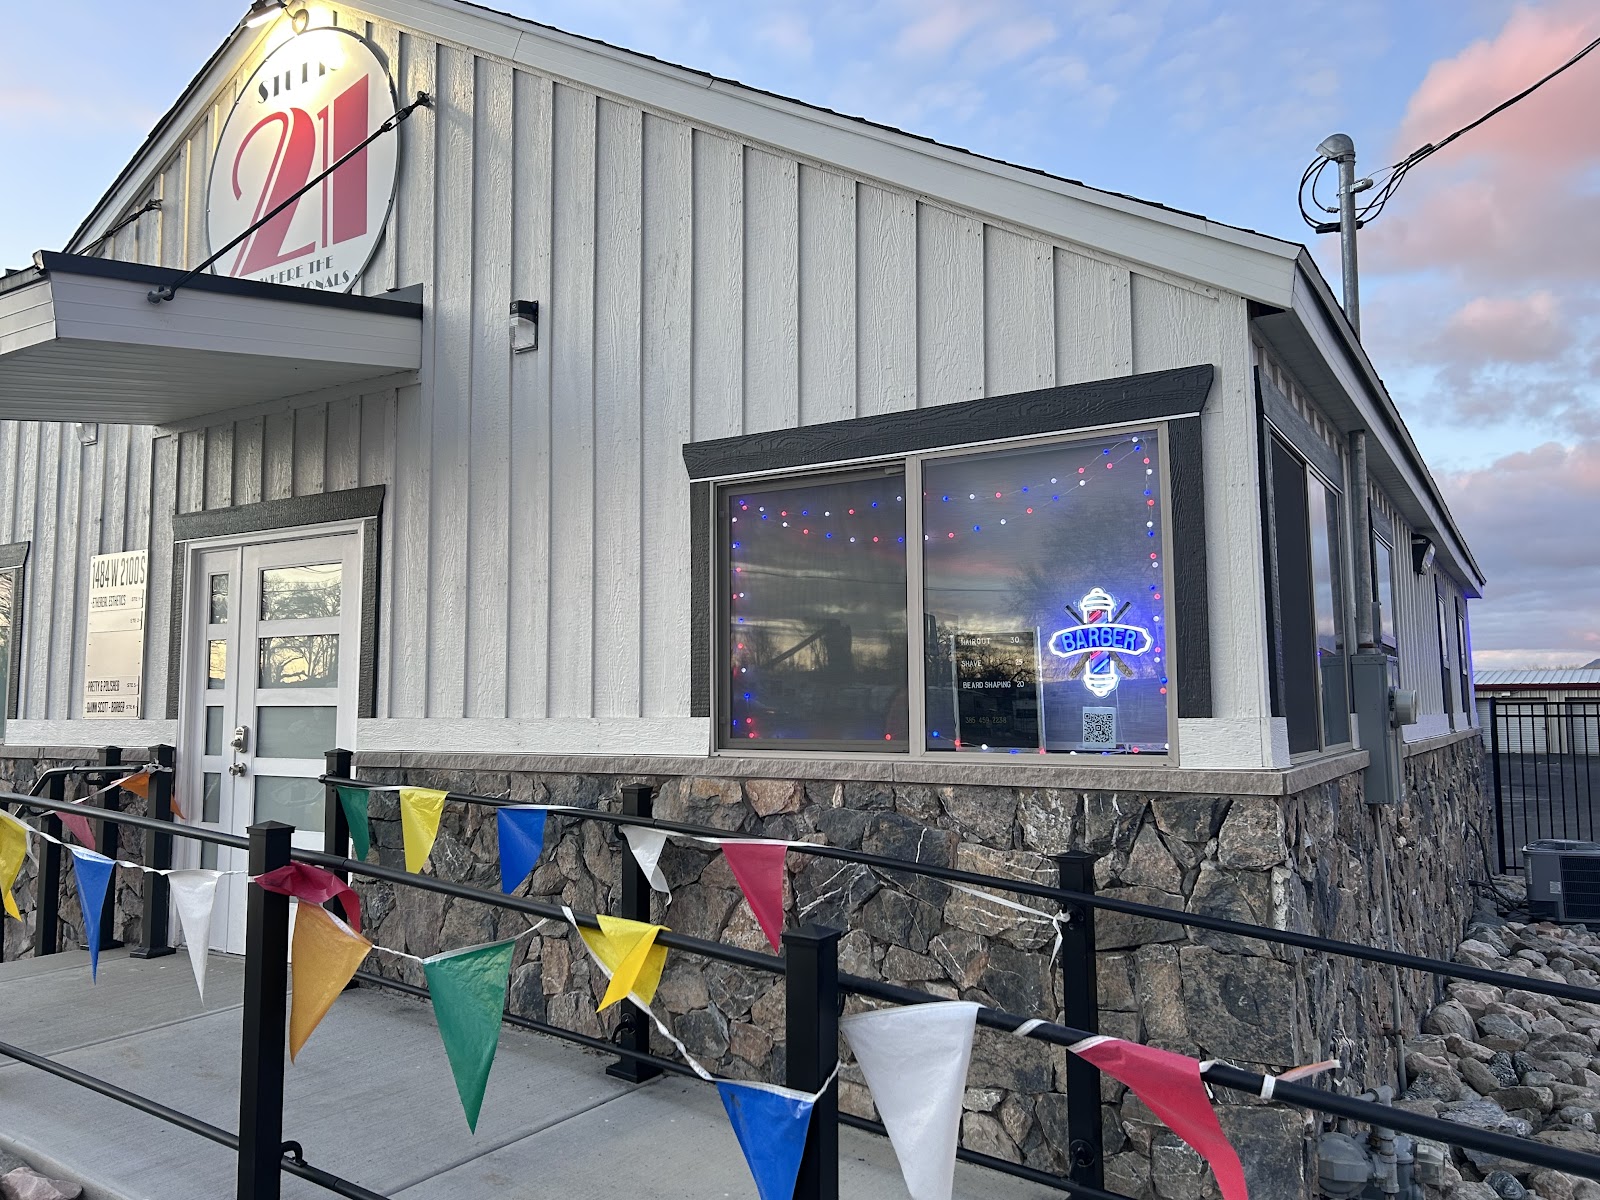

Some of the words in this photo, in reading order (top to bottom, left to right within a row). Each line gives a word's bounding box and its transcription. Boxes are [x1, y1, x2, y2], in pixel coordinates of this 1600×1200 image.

[229, 74, 369, 278] 21
[308, 255, 334, 274] THE
[92, 560, 110, 589] 1484
[111, 558, 120, 587] W
[120, 556, 140, 586] 2100
[140, 555, 146, 584] S
[1010, 636, 1020, 644] 30
[1061, 626, 1137, 652] BARBER
[961, 659, 983, 668] SHAVE
[1015, 658, 1023, 666] 25
[962, 681, 984, 689] BEARD
[984, 680, 1012, 689] SHAPING
[1016, 680, 1025, 688] 20
